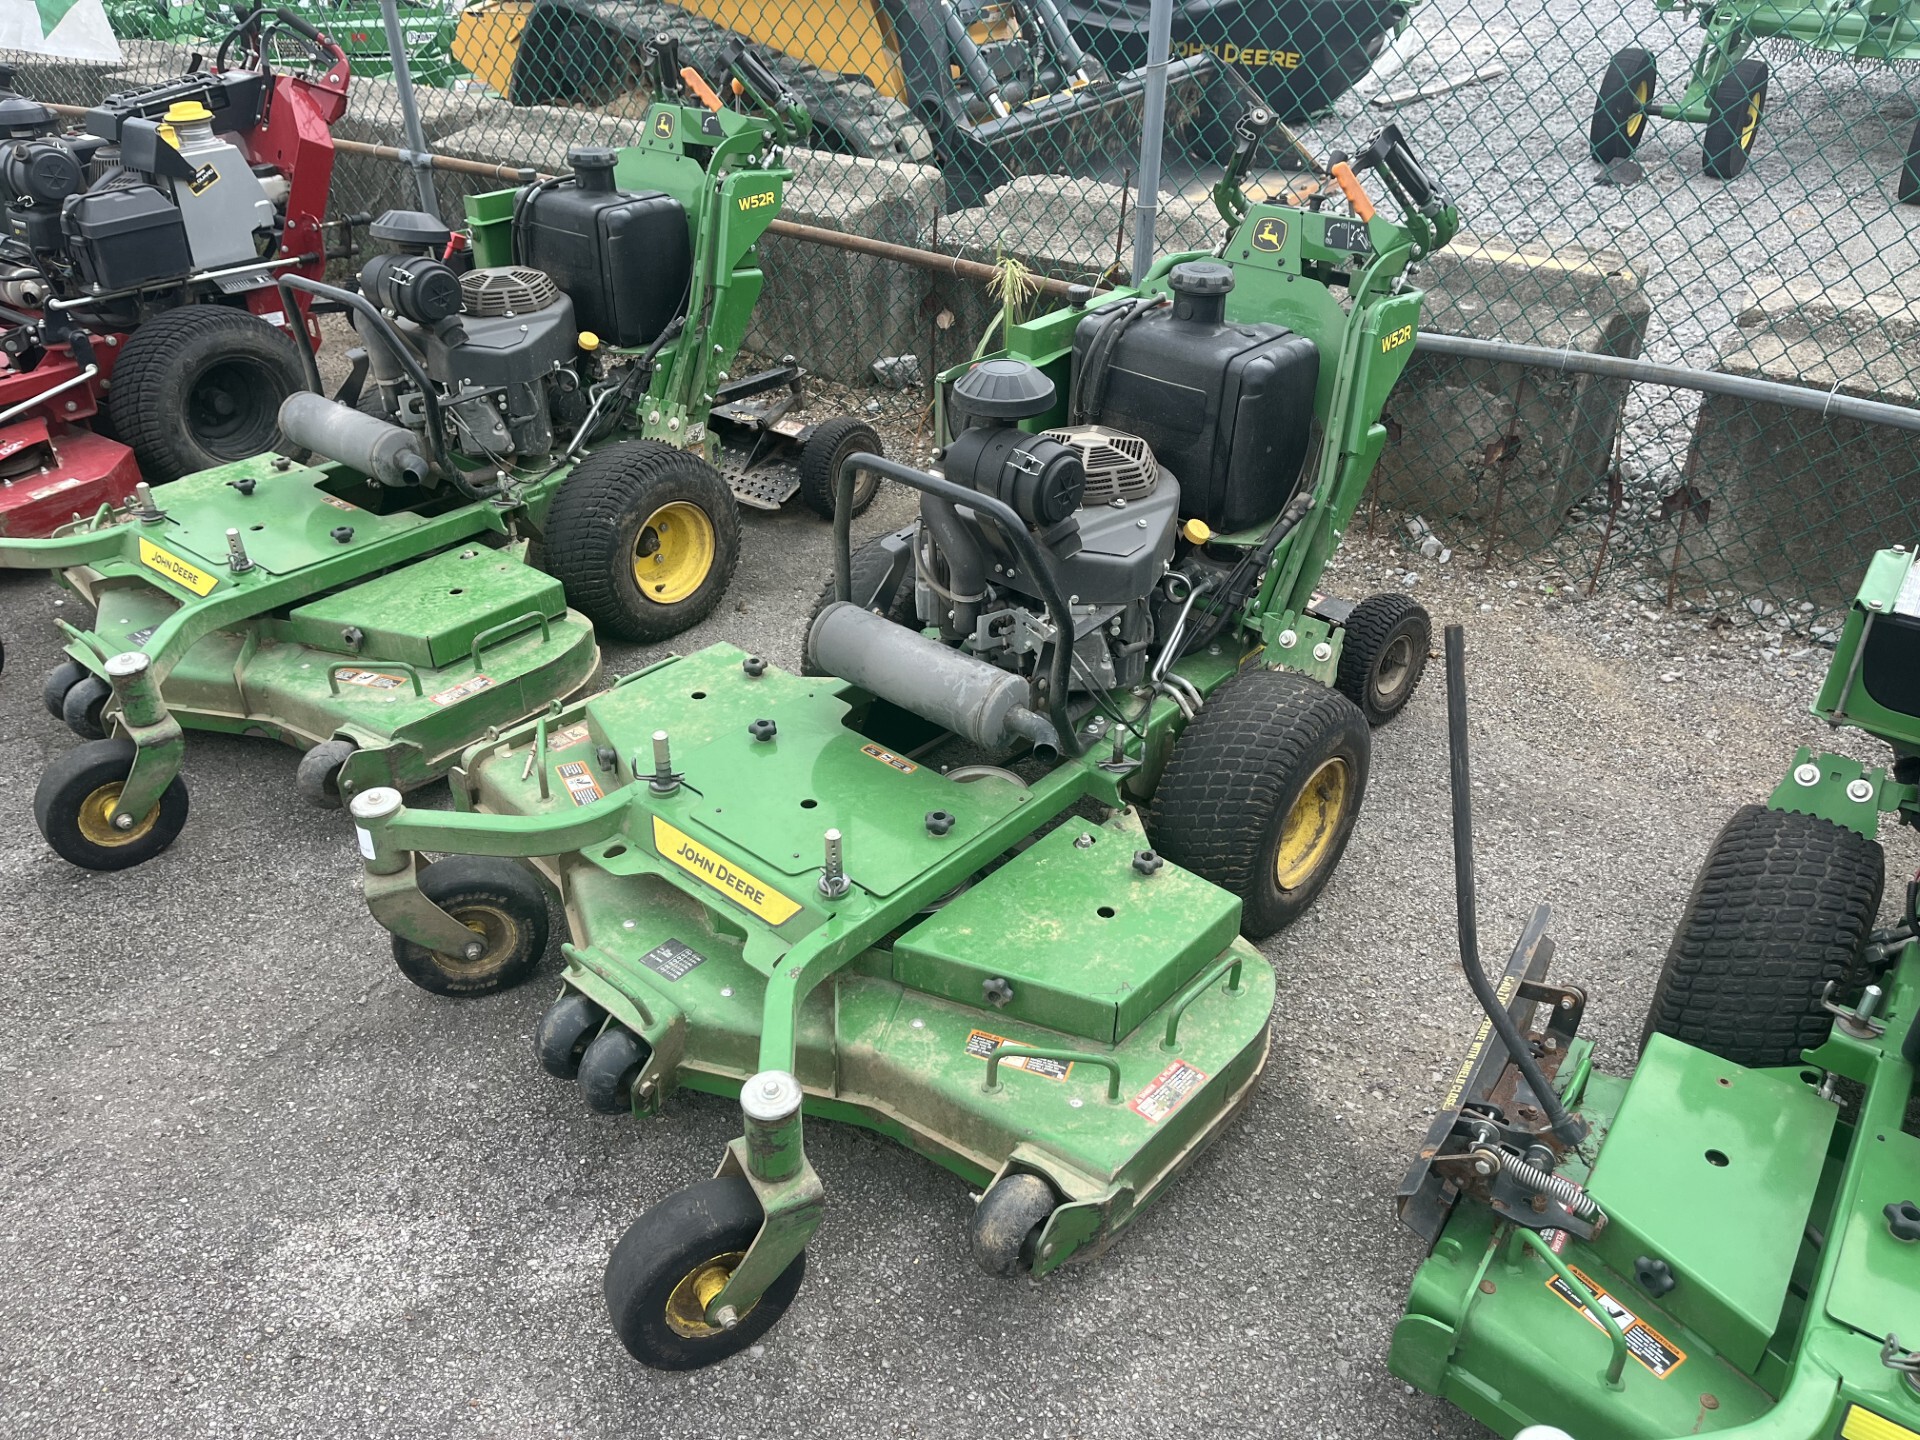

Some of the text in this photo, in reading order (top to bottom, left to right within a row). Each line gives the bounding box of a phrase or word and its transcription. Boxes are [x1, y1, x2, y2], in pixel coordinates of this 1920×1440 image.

[1223, 43, 1300, 69] DEERE
[738, 191, 775, 211] W52R
[1381, 324, 1411, 353] W52R
[151, 552, 199, 585] JOHN DEERE
[676, 843, 766, 906] JOHN DEERE
[1474, 1014, 1494, 1042] PERATE
[1466, 1041, 1484, 1060] WITH
[1455, 1060, 1475, 1085] SHIELD
[1551, 1229, 1567, 1253] PELIGRO
